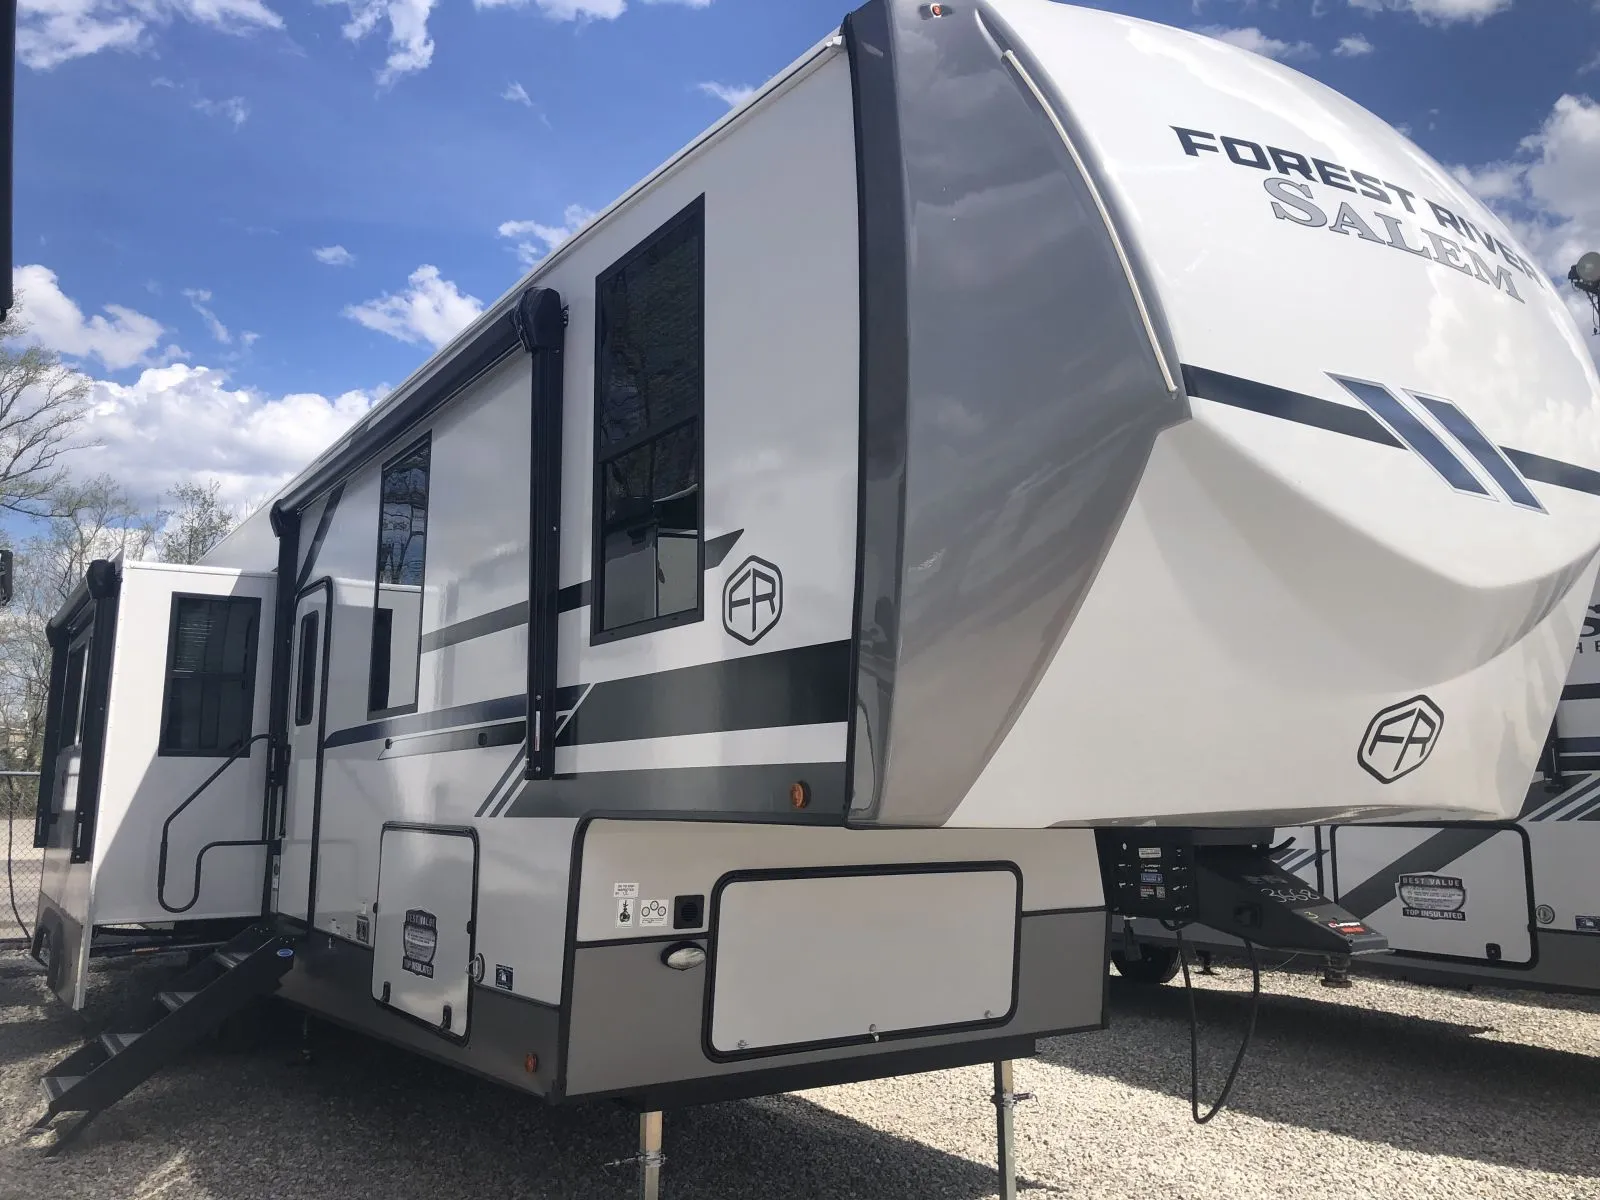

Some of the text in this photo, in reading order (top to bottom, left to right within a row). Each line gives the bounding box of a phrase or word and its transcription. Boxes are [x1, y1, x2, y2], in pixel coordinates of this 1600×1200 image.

[1168, 125, 1545, 289] FOREST RIVER
[1402, 877, 1461, 887] BEST VALUE
[1420, 909, 1463, 919] INSULATED
